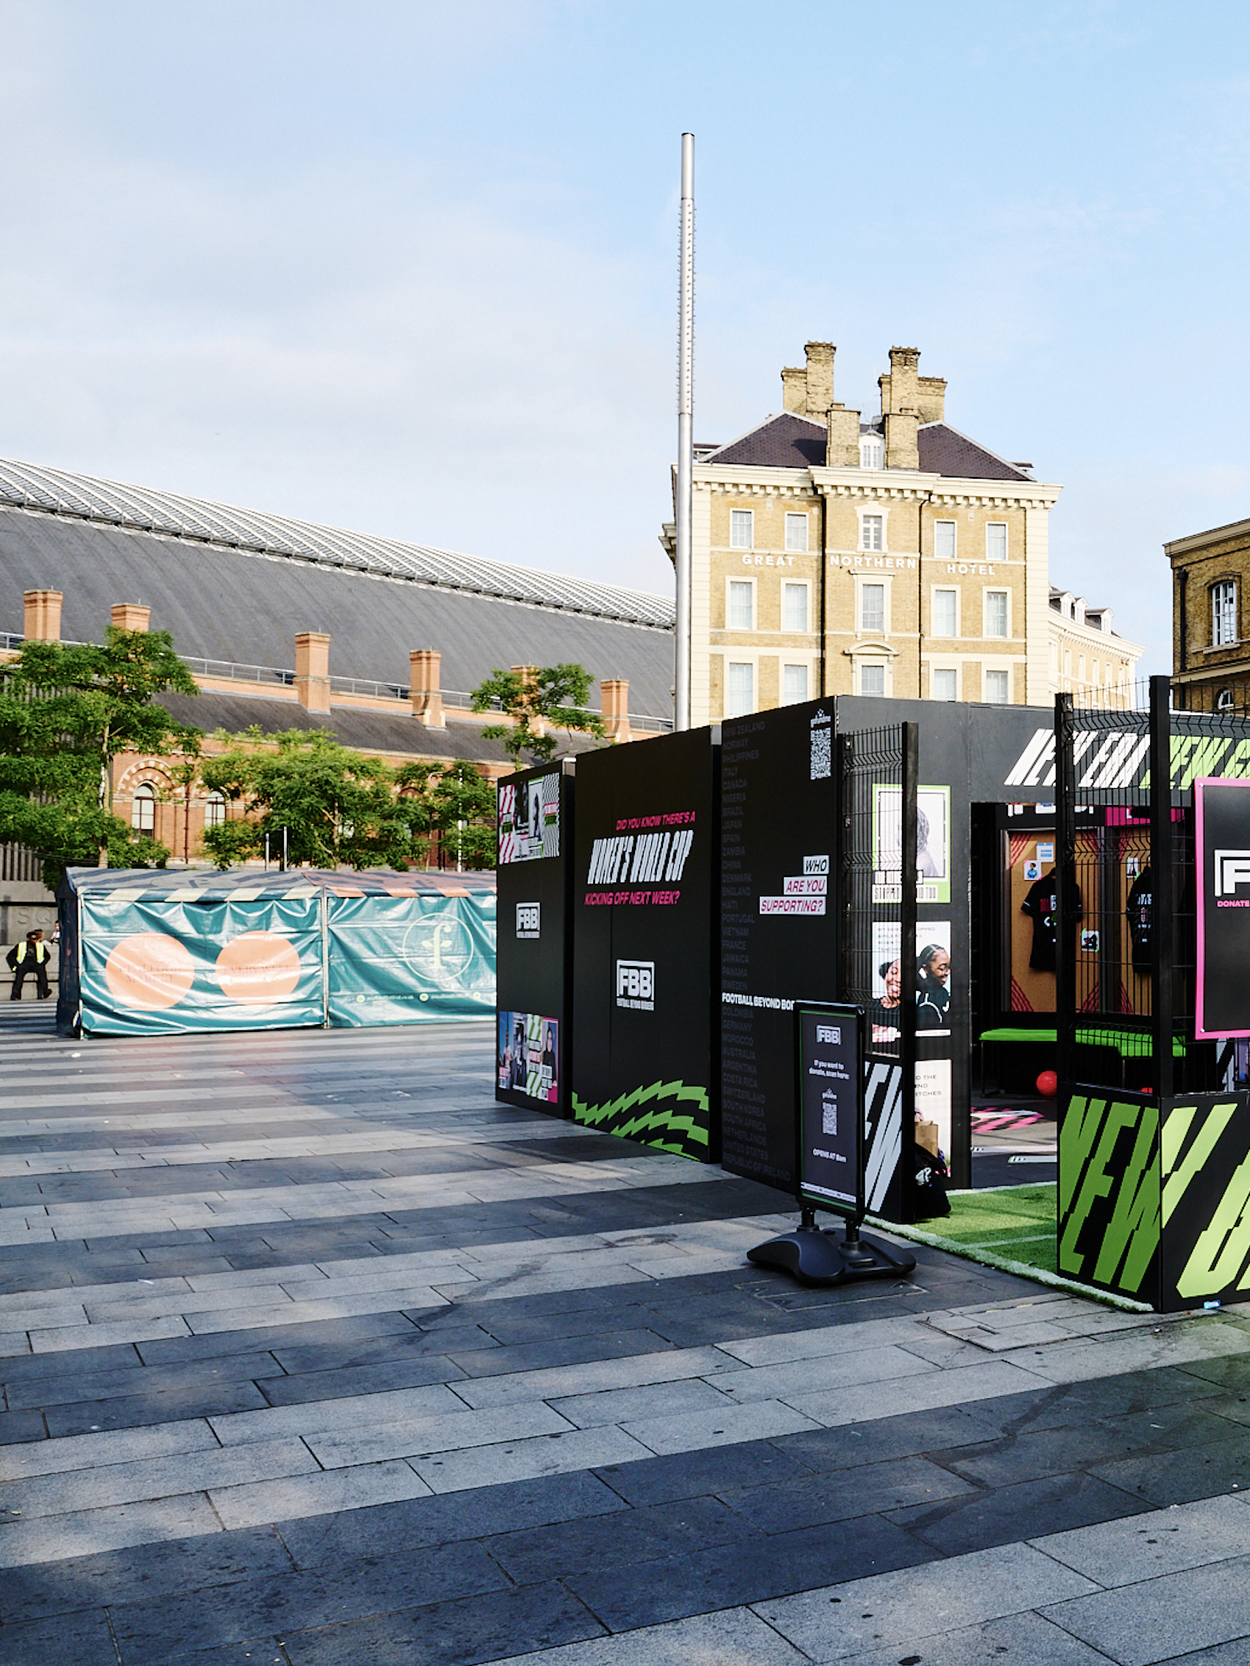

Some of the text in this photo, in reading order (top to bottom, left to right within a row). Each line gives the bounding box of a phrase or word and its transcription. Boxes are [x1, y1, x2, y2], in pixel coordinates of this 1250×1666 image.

[742, 555, 996, 575] GREAT NORTHERN HOTEL
[723, 721, 765, 738] NEW ZEALAND
[722, 738, 748, 750] NORWAY
[722, 750, 759, 763] PHILIPPINES
[1078, 732, 1150, 788] ERA
[722, 766, 739, 776] ITALY
[722, 779, 747, 790] CANADA
[722, 792, 746, 803] NIGERIA
[722, 806, 744, 817] BRAZIL
[616, 810, 696, 831] DID YOU KNOW THERE'S A
[722, 820, 742, 830] JAPAN
[722, 833, 740, 843] SPAIN
[587, 829, 694, 884] WOMEN'S WORLD CUP
[722, 847, 745, 857] ZAMBIA
[722, 860, 741, 869] CHINA
[806, 859, 827, 872] WHO
[722, 873, 752, 883] DENMARK
[722, 886, 751, 896] ENGLAND
[786, 880, 826, 892] ARE YOU
[584, 890, 681, 905] KICKING OFF NEXT WEEK?
[722, 900, 738, 909] HAITI
[761, 900, 823, 912] SUPPORTING?
[518, 908, 538, 930] FBB
[722, 914, 755, 923] PORTUGAL
[722, 927, 749, 937] VIETNAM
[722, 940, 746, 950] FRANCE
[722, 953, 749, 964] JAMAICA
[722, 967, 748, 977] PANAMA
[619, 967, 652, 998] FBB
[722, 980, 748, 991] SWEDEN
[722, 992, 753, 1006] FOOTBALL
[753, 995, 780, 1009] BEYOND
[722, 1006, 754, 1019] COLOMBIA
[722, 1020, 752, 1032] GERMANY
[722, 1033, 754, 1046] MOROCCO
[819, 1029, 839, 1045] FBB
[722, 1046, 756, 1060] AUSTRALIA
[722, 1059, 757, 1074] ARGENTINA
[722, 1073, 758, 1088] COSTA RICA
[722, 1086, 766, 1104] SWITZERLAND
[722, 1099, 765, 1117] SOUTH KOREA
[722, 1112, 767, 1132] SOUTH AFRICA
[723, 1125, 767, 1146] NETHERLANDS
[723, 1139, 769, 1160] UNITED STATES
[723, 1152, 791, 1182] REPUBLIC OF IRELAND
